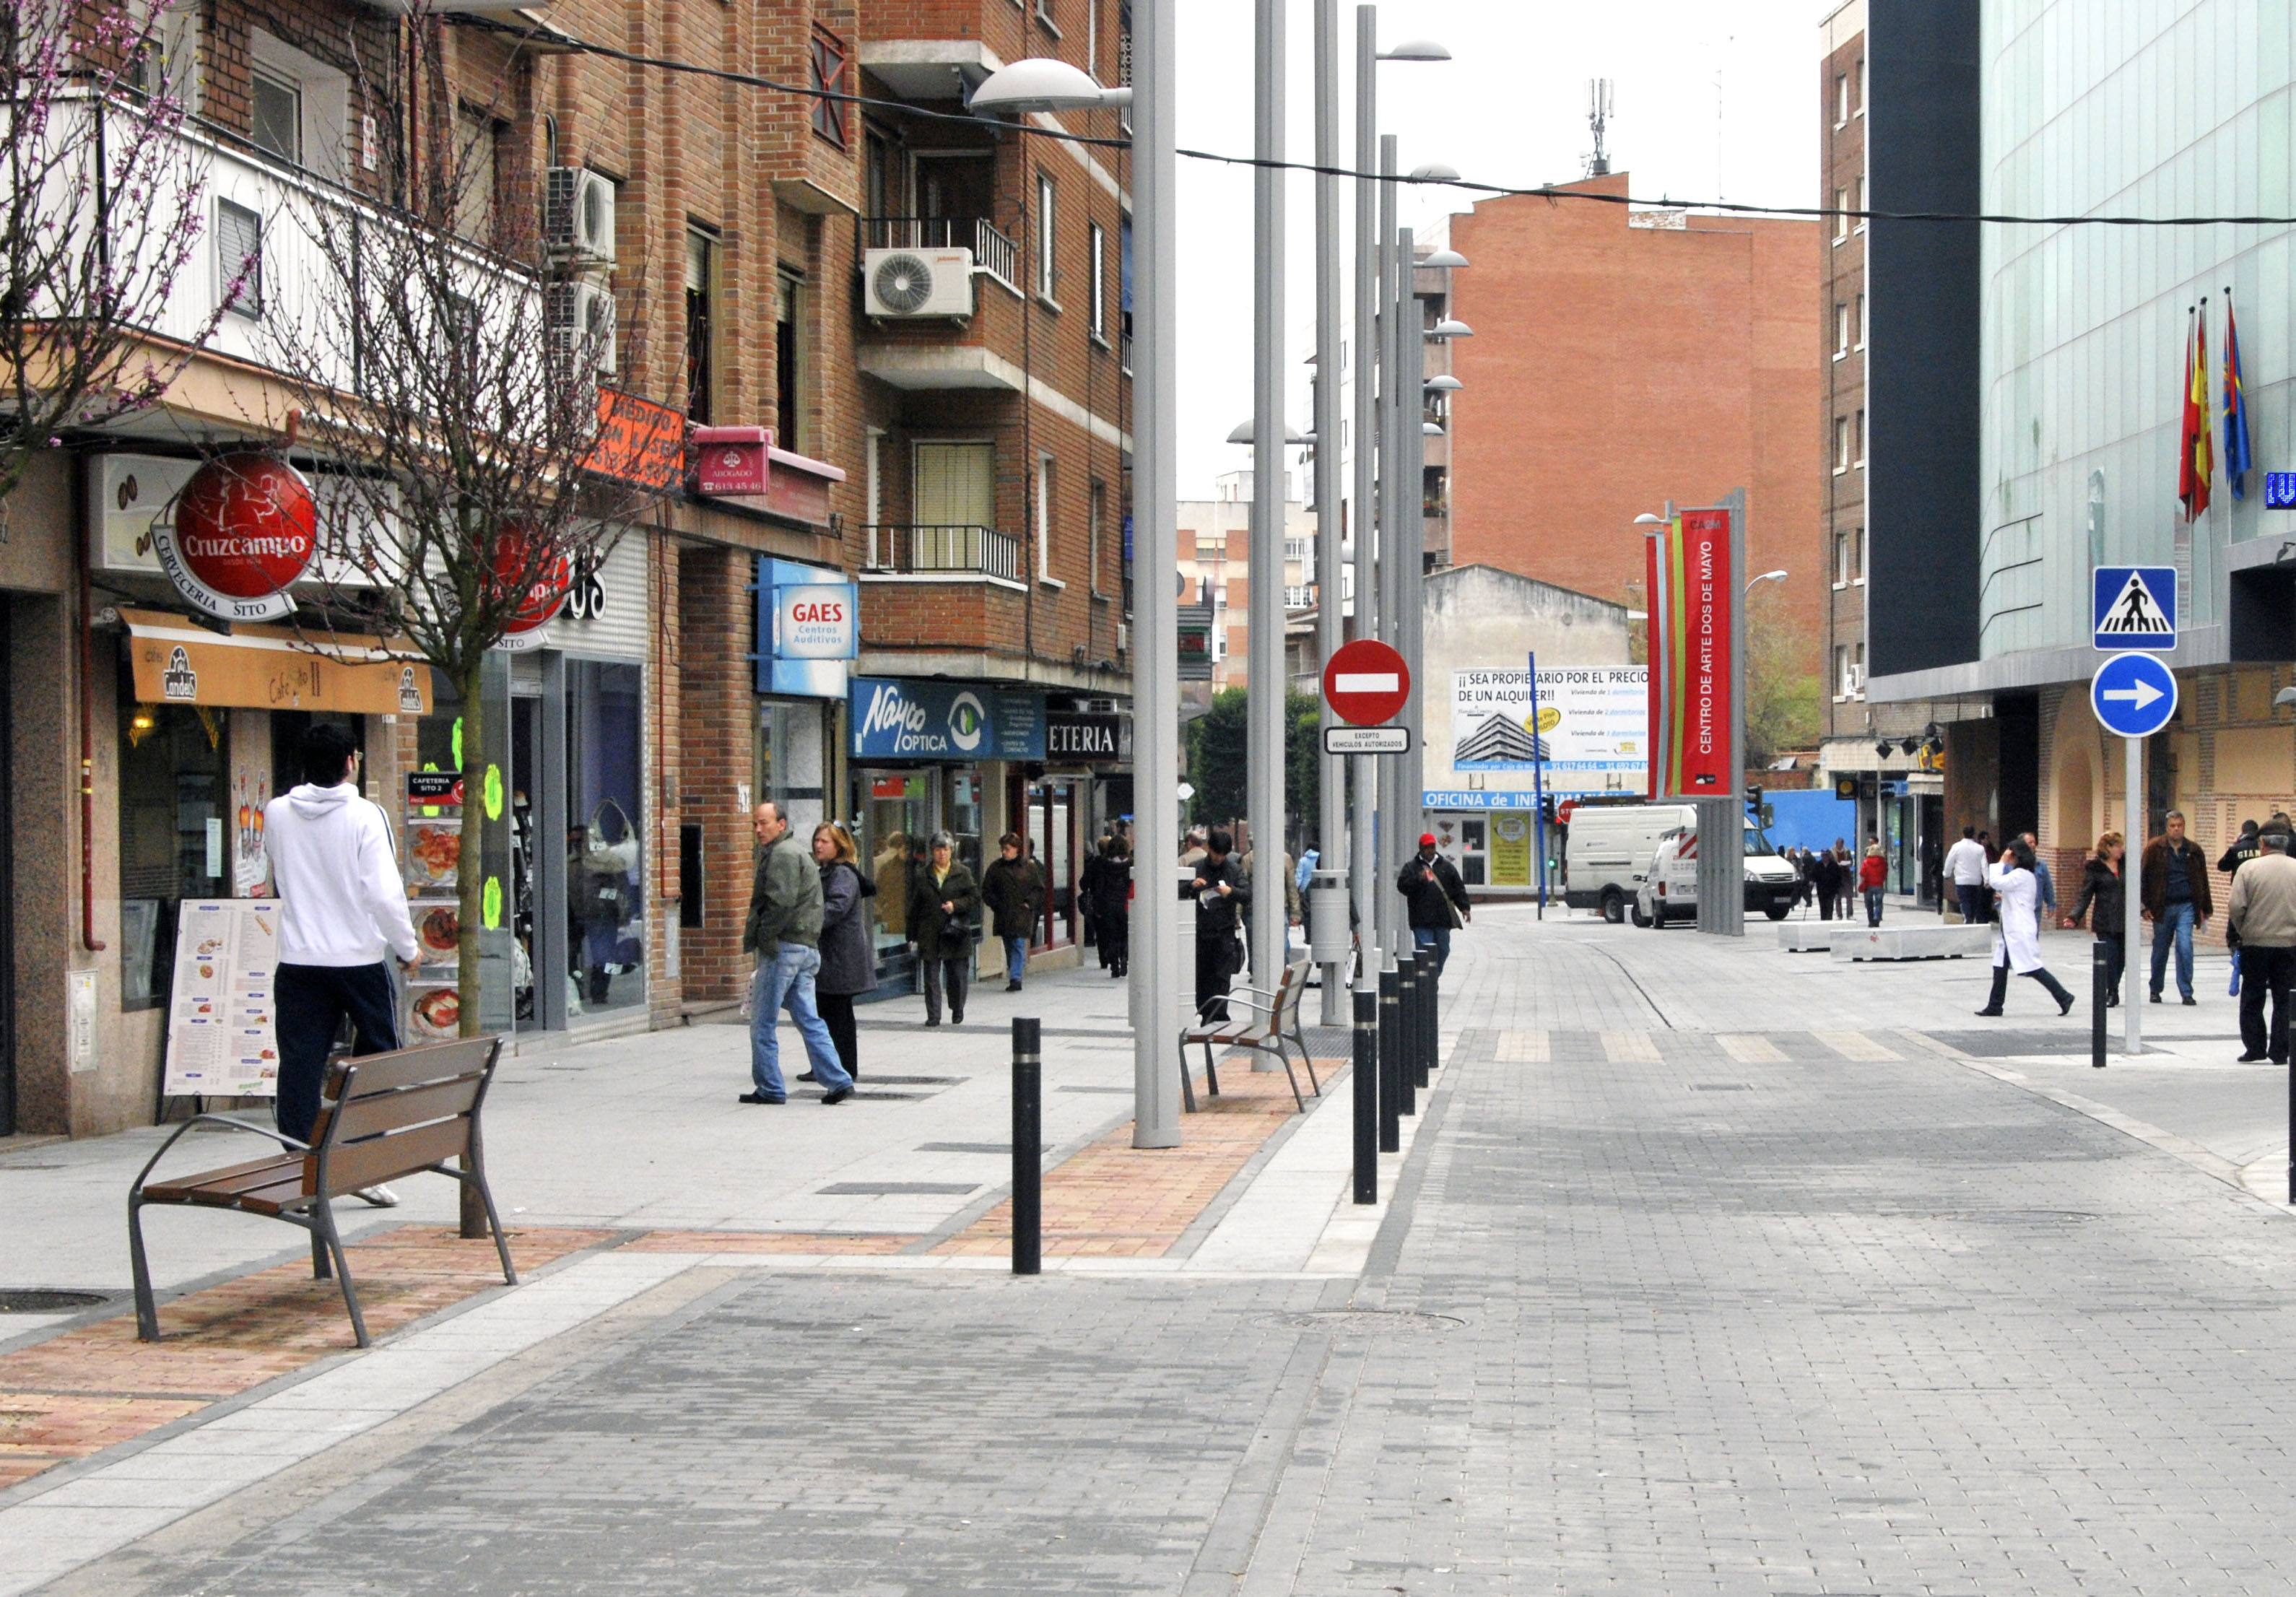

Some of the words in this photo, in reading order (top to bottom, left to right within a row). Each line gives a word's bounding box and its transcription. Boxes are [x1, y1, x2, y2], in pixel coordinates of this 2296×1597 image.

[715, 482, 733, 491] 613
[734, 482, 747, 490] 45
[749, 482, 762, 490] 46
[186, 535, 306, 558] Cruzcampo
[1700, 541, 1712, 580] MAYO
[157, 534, 217, 610] CERVECERIA
[233, 602, 267, 616] SITO
[1701, 583, 1712, 601] DE
[793, 604, 843, 622] GAES
[1701, 604, 1712, 633] DOS
[798, 625, 838, 634] Centros
[497, 638, 525, 648] SITO
[793, 635, 843, 643] Auditivos
[1701, 637, 1712, 673] ARTE
[1469, 673, 1489, 684] SEA
[1566, 672, 1588, 684] POR
[1592, 672, 1604, 683] EL
[1609, 671, 1649, 683] PRECIO
[1700, 676, 1712, 695] DE
[1458, 690, 1472, 702] DE
[1476, 690, 1492, 702] UN
[862, 684, 926, 753] Nayco
[1699, 697, 1712, 754] CENTRO
[902, 734, 948, 752] OPTICA
[1425, 793, 1484, 806] OFICINA
[1490, 792, 1508, 806] de
